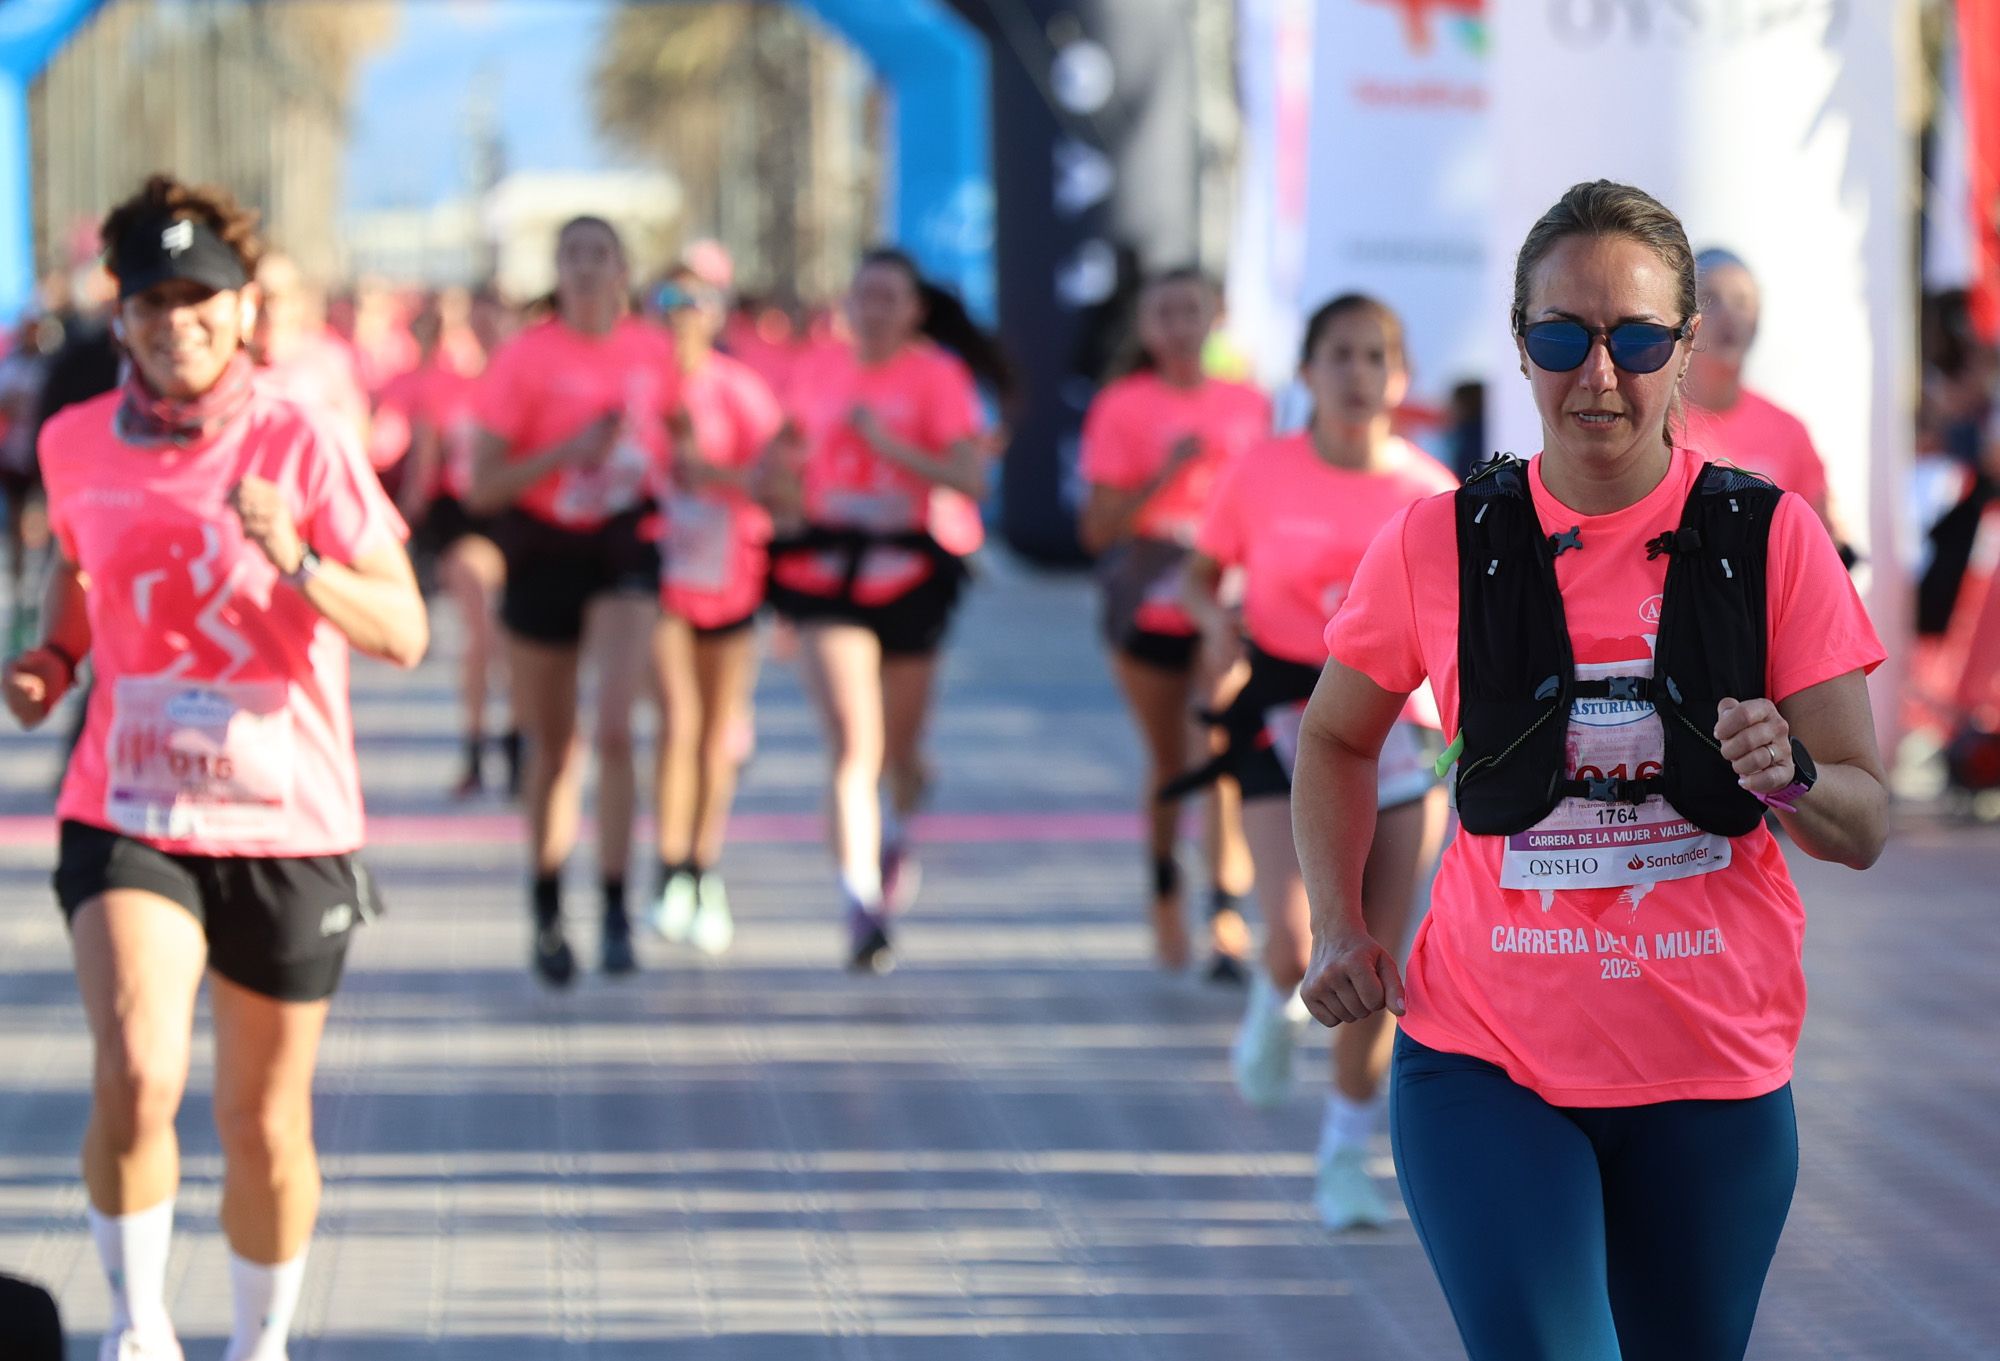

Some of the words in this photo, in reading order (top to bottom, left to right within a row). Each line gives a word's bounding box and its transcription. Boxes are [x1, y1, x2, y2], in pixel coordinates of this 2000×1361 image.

[1571, 700, 1654, 716] ASTURIANA
[1596, 807, 1638, 825] 1764
[1529, 833, 1576, 847] CARRERA
[1579, 831, 1593, 845] DE
[1595, 830, 1610, 844] LA
[1613, 827, 1651, 843] MUJER
[1529, 857, 1598, 875] OYSHO
[1646, 846, 1709, 869] Santander
[1491, 925, 1590, 954] CARRERA
[1594, 927, 1622, 954] DE
[1655, 927, 1727, 960] MUJER
[1600, 958, 1642, 980] 2025
